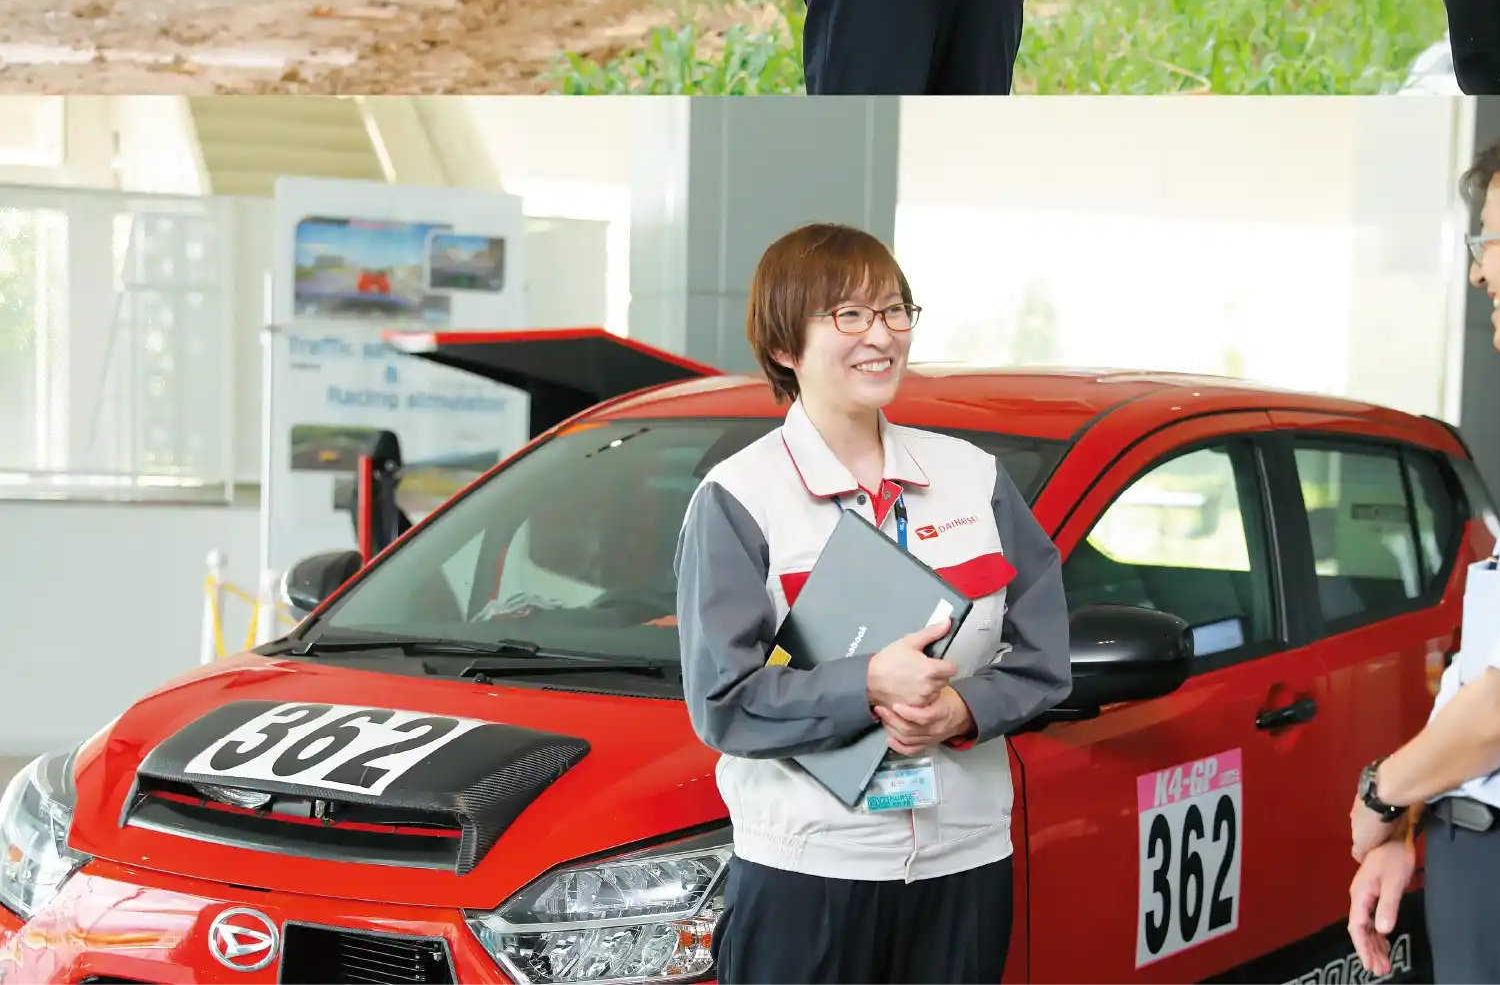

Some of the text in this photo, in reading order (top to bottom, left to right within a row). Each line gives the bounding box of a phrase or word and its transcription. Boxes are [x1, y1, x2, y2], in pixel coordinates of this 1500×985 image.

[209, 704, 460, 789] 362
[1153, 757, 1219, 808] K4-GP
[1145, 794, 1236, 955] 362
